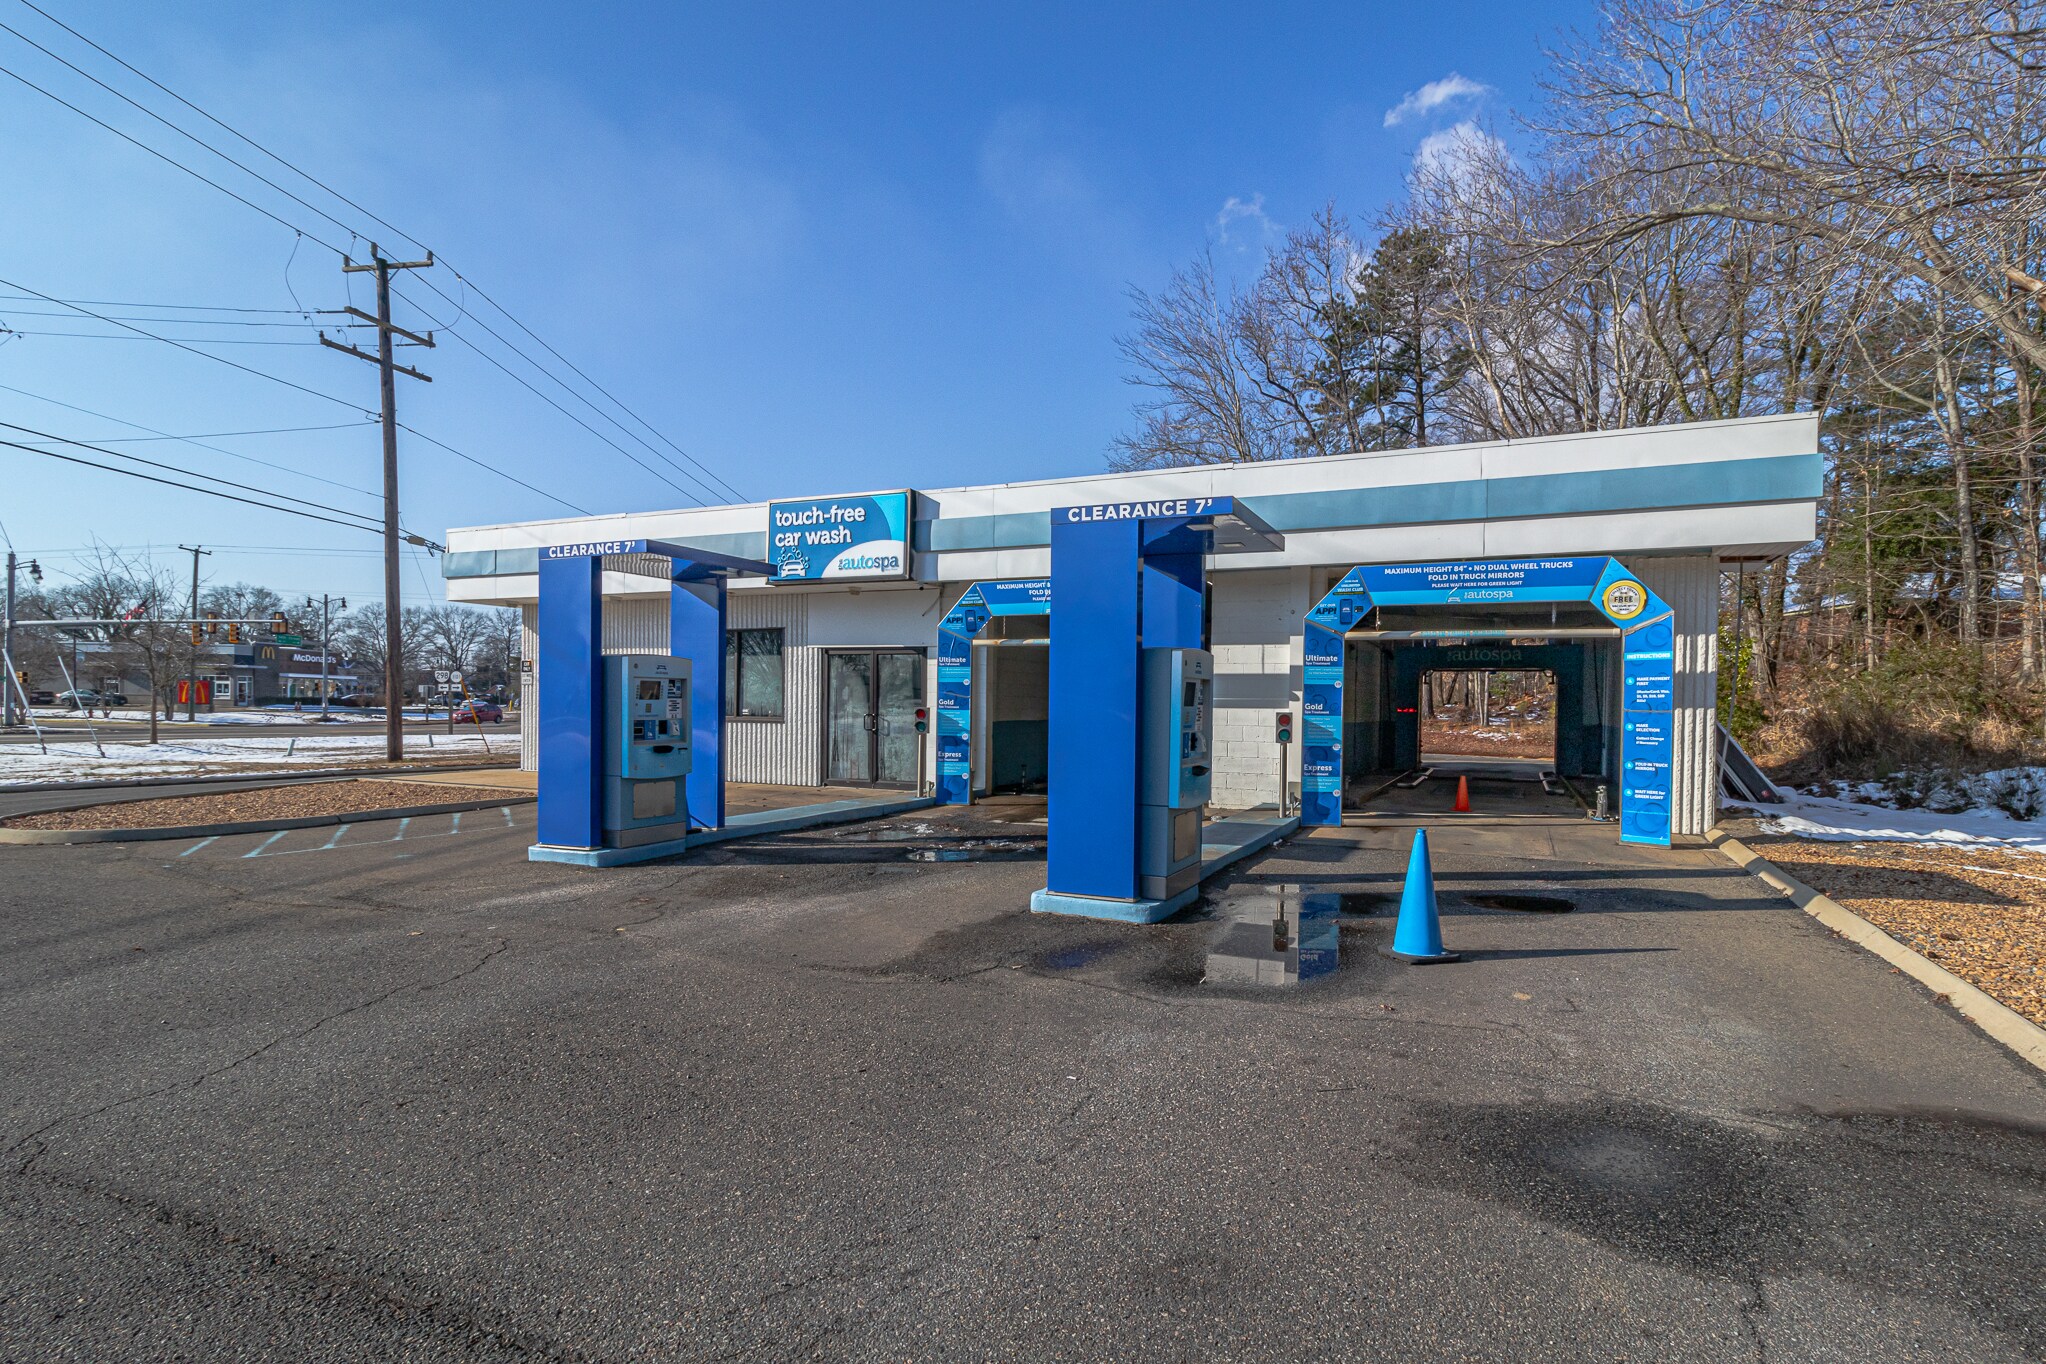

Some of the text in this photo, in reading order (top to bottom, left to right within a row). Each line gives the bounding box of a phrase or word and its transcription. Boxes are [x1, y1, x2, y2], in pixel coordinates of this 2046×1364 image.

[1068, 500, 1187, 522] CLEARANCE
[776, 505, 866, 526] touch-free
[775, 525, 852, 547] car wash
[549, 542, 621, 558] CLEARANCE
[1384, 567, 1422, 575] MAXIMUM
[1423, 565, 1452, 573] HEIGHT
[1487, 563, 1509, 571] DUAL
[1510, 562, 1538, 570] WHEEL
[1540, 561, 1573, 569] TRUCKS
[1487, 571, 1525, 579] MIRRORS
[1613, 595, 1634, 603] FREE
[1305, 654, 1338, 662] Ultimate
[1626, 652, 1671, 660] INSTRUCTIONS
[436, 671, 449, 679] 298
[938, 698, 955, 706] Gold
[1304, 702, 1323, 710] Gold
[938, 750, 962, 759] Express
[1303, 763, 1333, 772] Express
